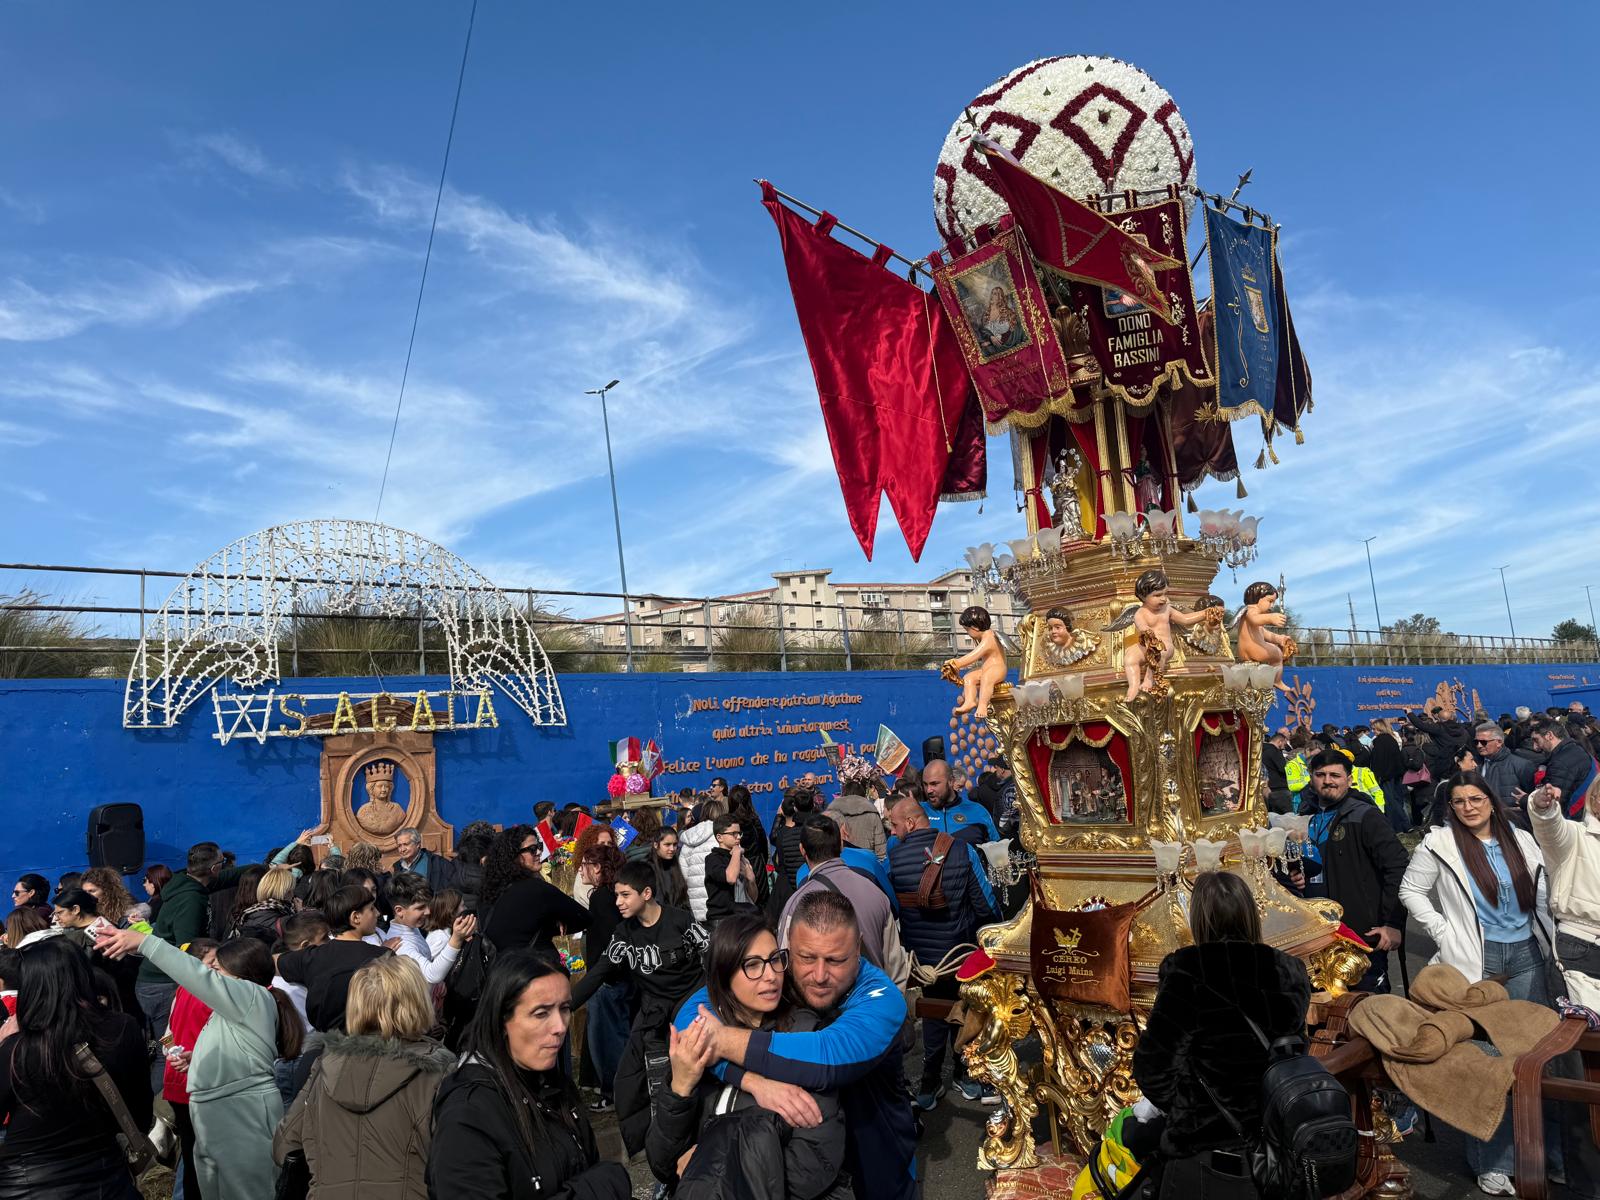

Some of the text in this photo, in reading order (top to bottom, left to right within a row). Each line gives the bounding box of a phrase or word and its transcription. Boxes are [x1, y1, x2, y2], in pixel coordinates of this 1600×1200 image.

[1118, 313, 1151, 333] DONO
[1107, 328, 1164, 352] FAMIGLIA
[1113, 346, 1160, 368] BASSINI
[722, 696, 779, 712] offendere
[779, 692, 820, 709] patriam
[663, 757, 700, 773] Felice
[750, 752, 769, 765] che
[775, 750, 788, 763] ha
[860, 744, 877, 755] por
[778, 775, 790, 790] di
[1052, 955, 1088, 965] CEREO
[1046, 965, 1066, 976] Luigi
